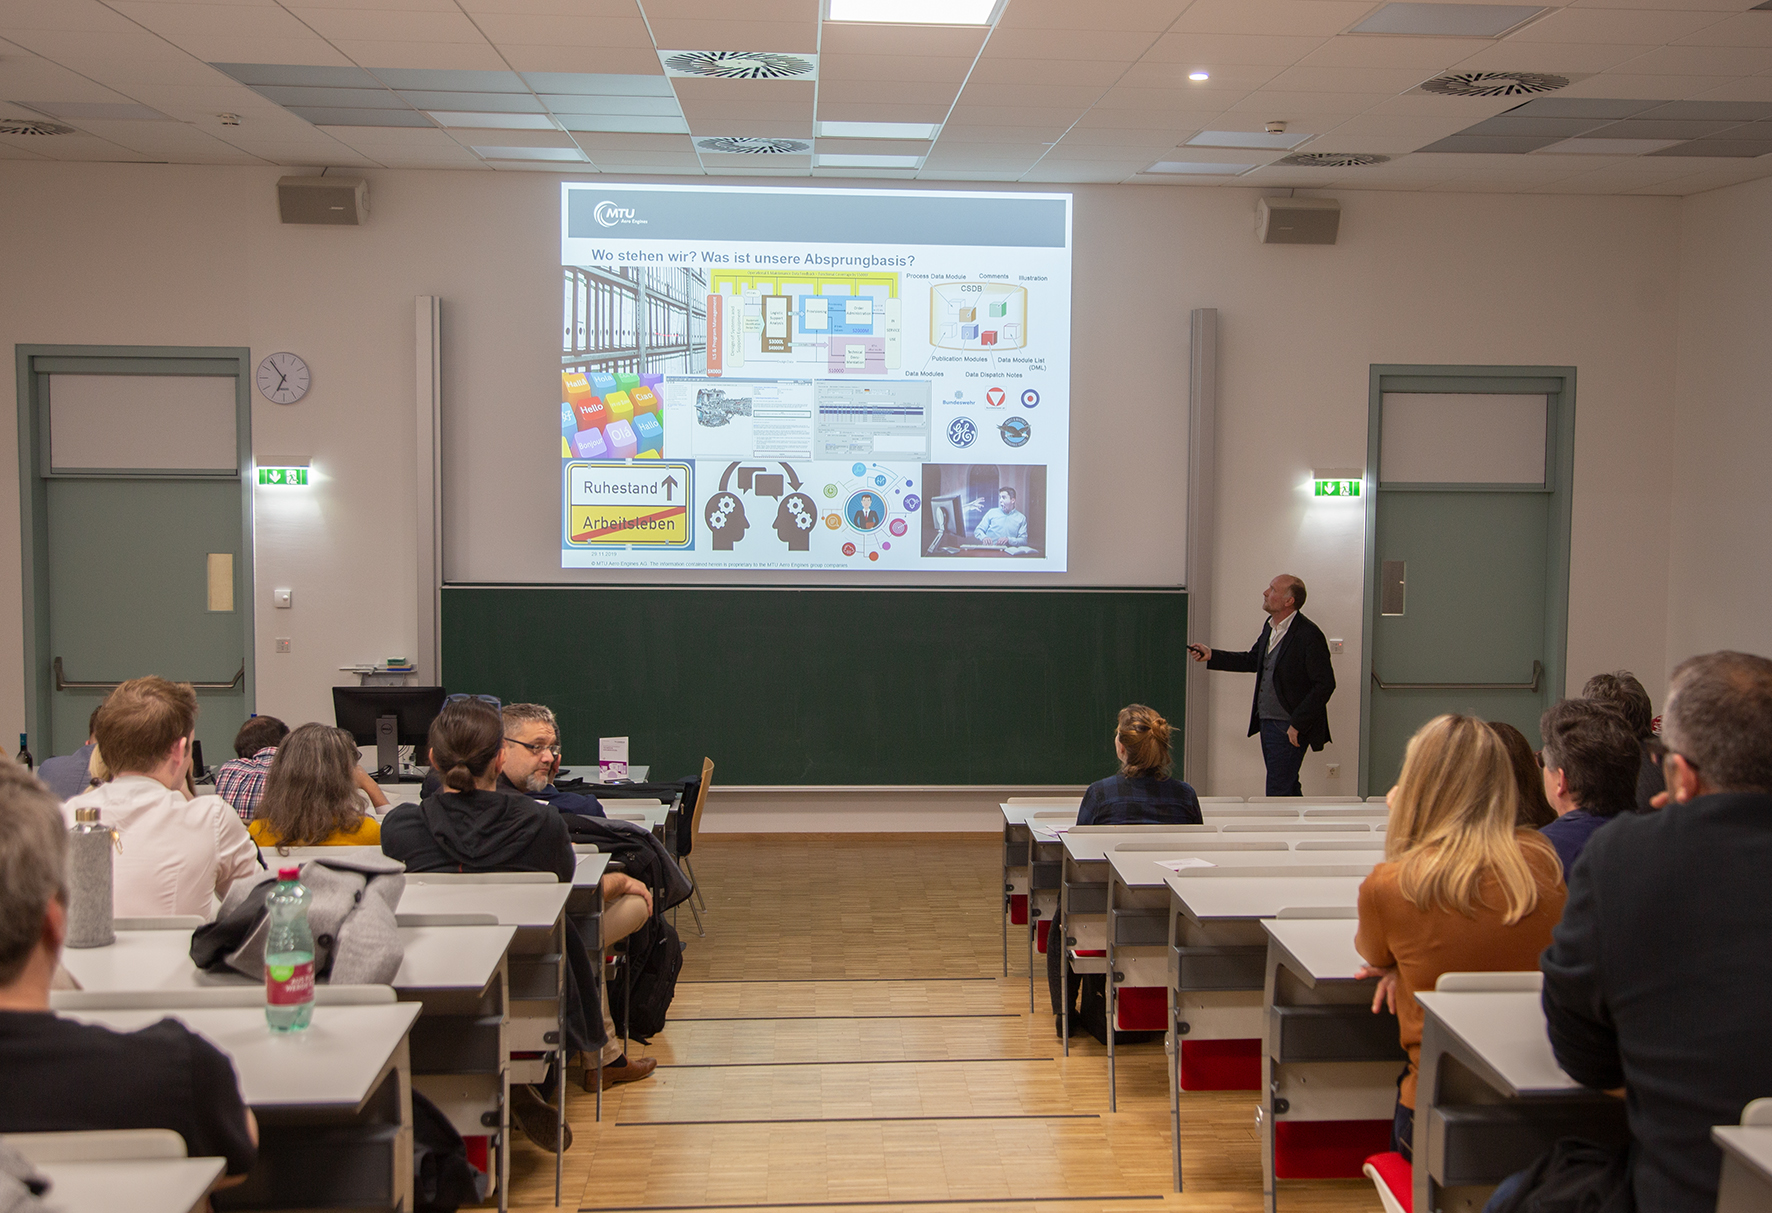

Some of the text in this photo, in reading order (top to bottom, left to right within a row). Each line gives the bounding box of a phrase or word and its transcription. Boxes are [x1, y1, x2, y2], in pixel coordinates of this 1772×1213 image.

[606, 208, 635, 219] MTU
[591, 249, 915, 267] Wo stehen wir? Was ist unsere Absprungbasis?
[594, 374, 613, 383] Hola
[635, 392, 653, 401] Ciao
[580, 403, 604, 414] Hello
[638, 420, 659, 431] Hallo
[611, 427, 632, 440] Olá
[578, 438, 603, 450] Bonjour
[584, 481, 657, 494] Ruhestand
[583, 516, 675, 530] Arbeitsleben
